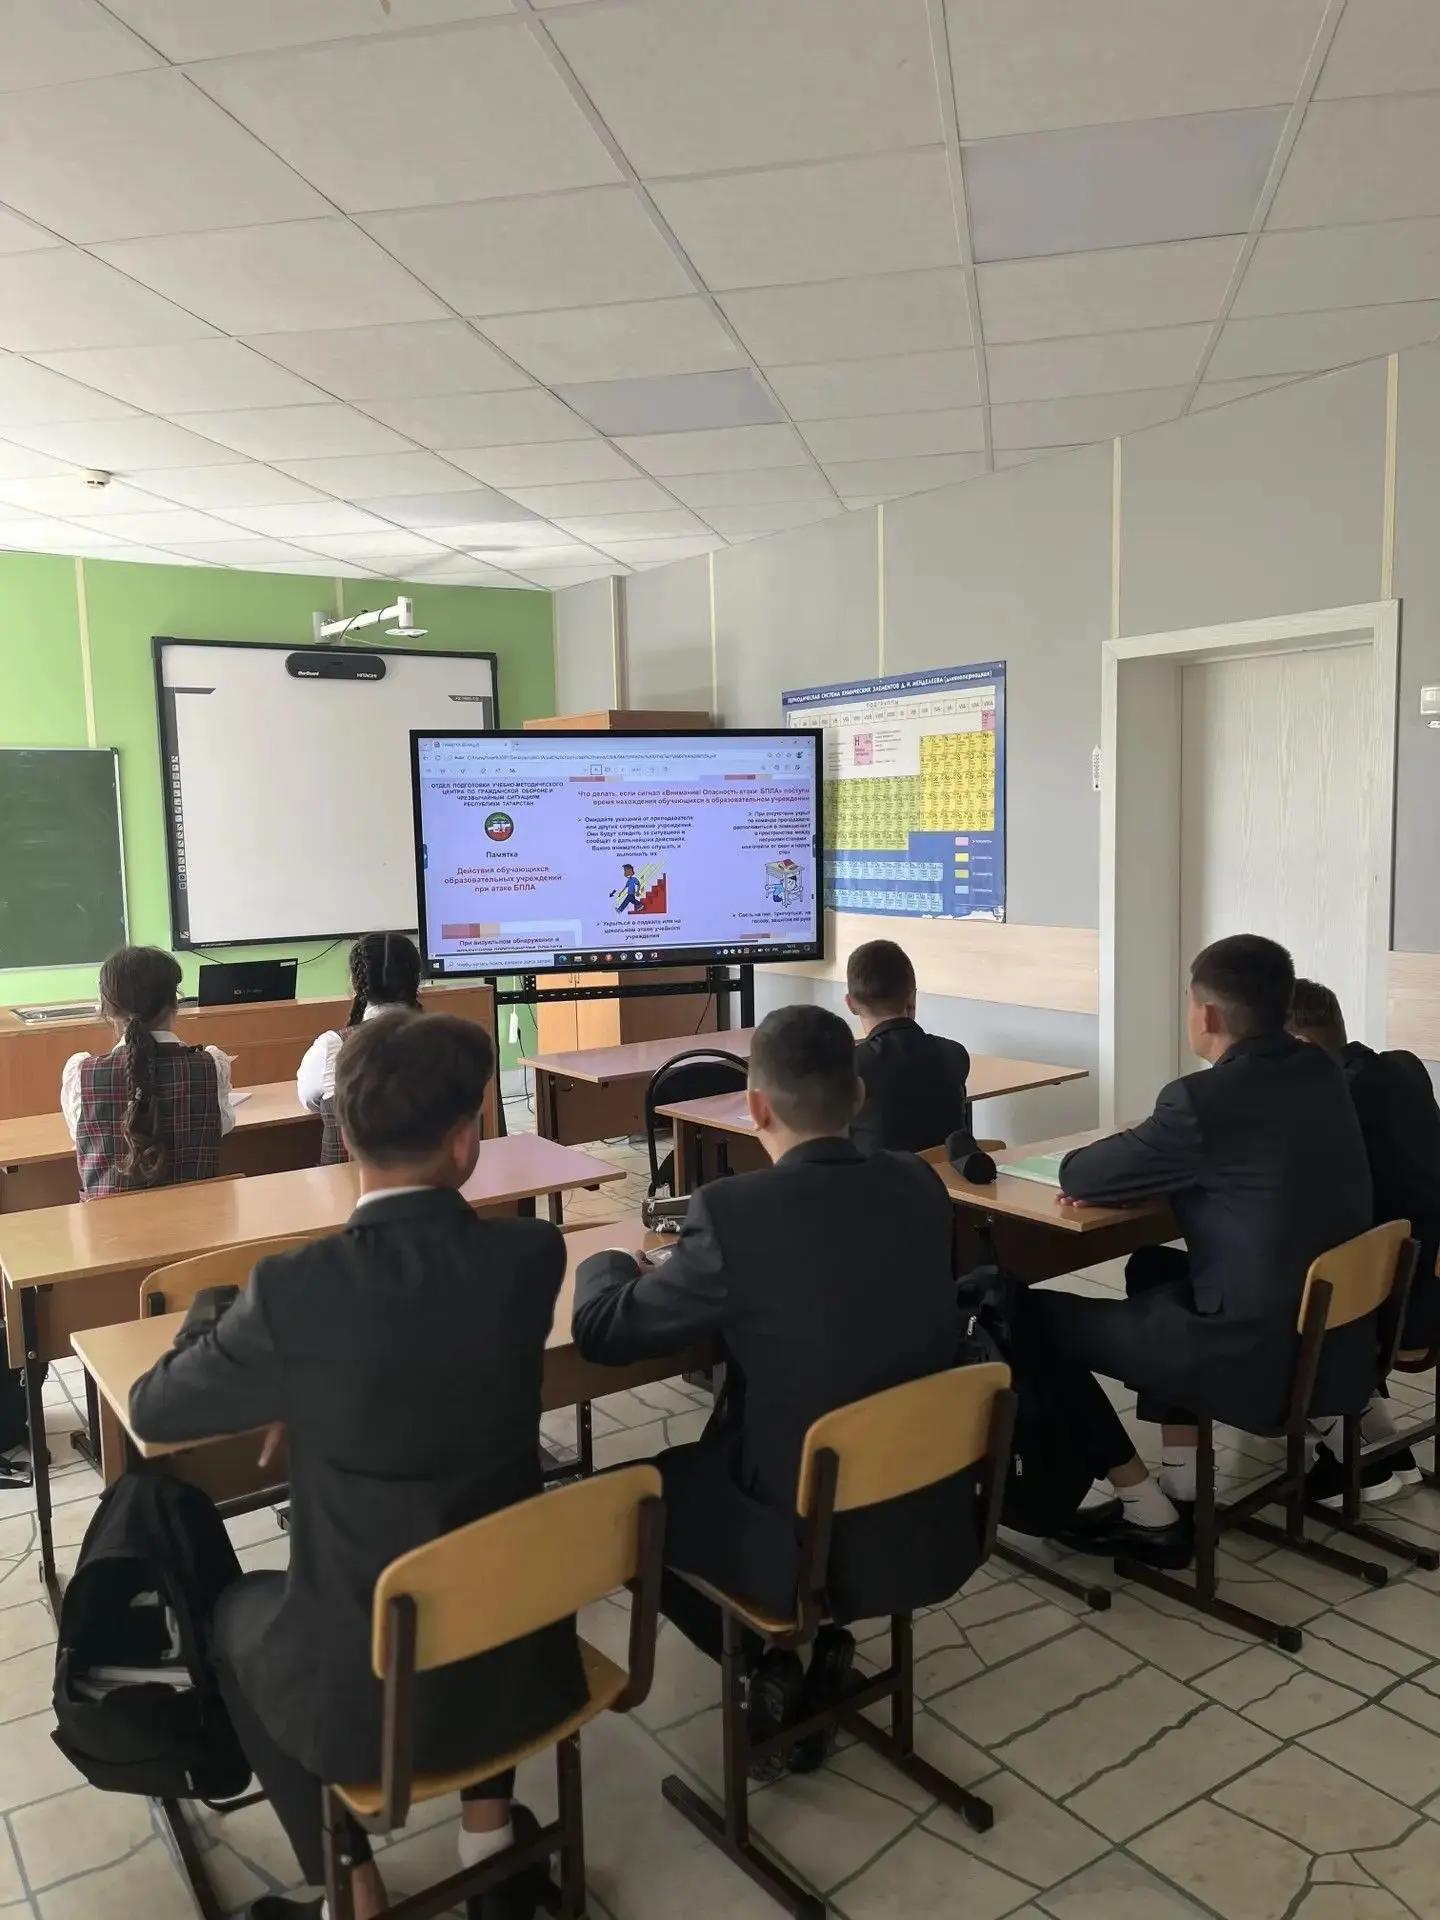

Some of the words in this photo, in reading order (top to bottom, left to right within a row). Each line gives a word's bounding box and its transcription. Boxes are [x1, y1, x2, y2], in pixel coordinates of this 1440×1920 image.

[788, 694, 820, 704] ПЕРИОДИЧЕСКАЯ
[842, 688, 872, 696] ХИМИЧЕСКИХ
[873, 683, 900, 692] ЭЛЕМЕНТОВ
[912, 678, 943, 687] МЕНДЕЛЕЕВА
[658, 798, 704, 806] обучающихся
[712, 797, 770, 805] образовательном
[457, 868, 494, 876] Действия
[496, 866, 548, 874] обучающихся
[444, 876, 514, 885] образовательных
